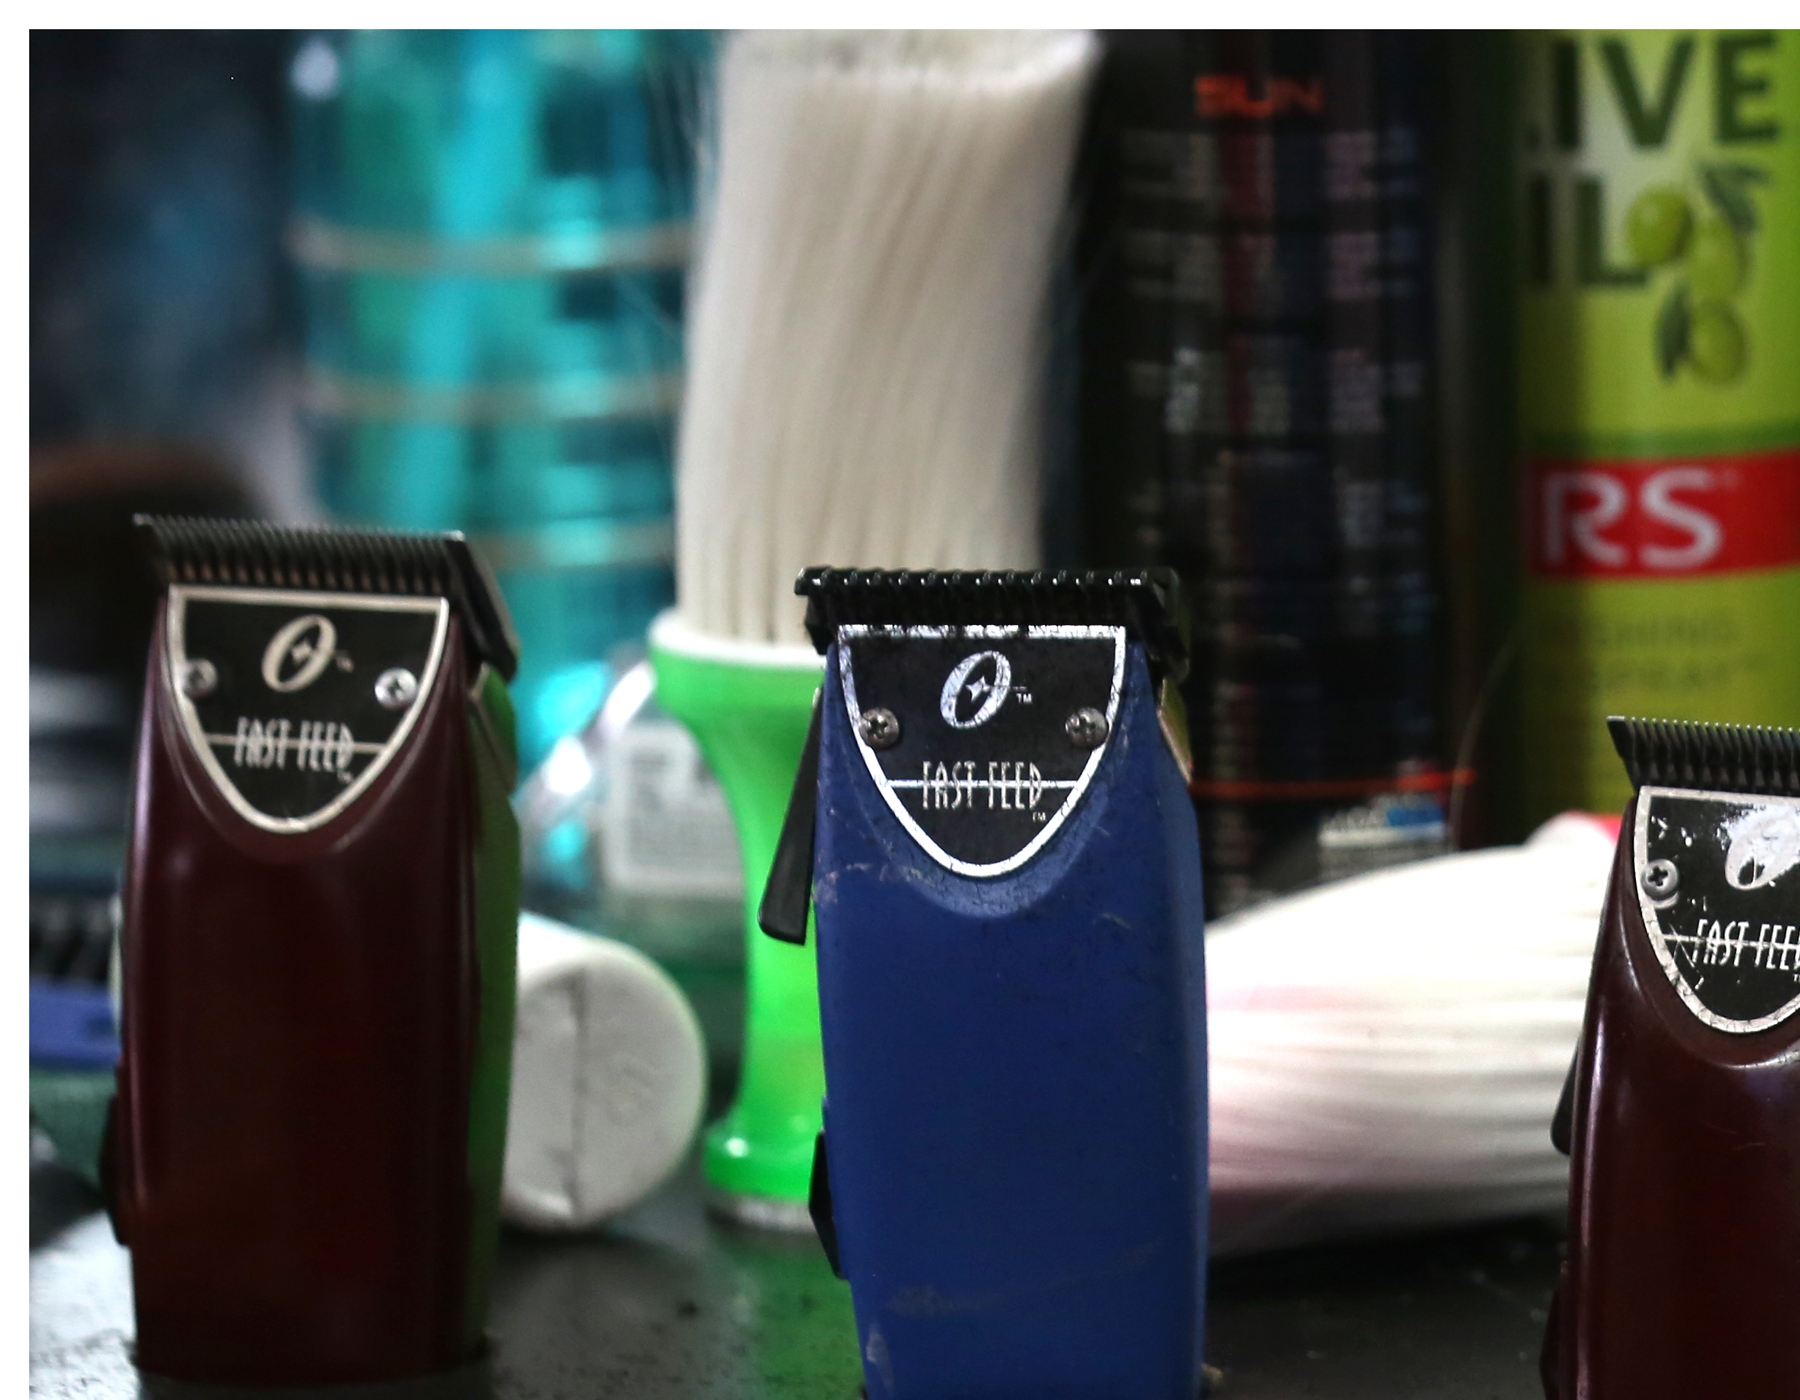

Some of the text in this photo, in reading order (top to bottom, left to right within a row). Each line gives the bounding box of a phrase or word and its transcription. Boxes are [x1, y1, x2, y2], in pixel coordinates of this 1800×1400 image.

[234, 716, 355, 772] FAST FEED
[922, 760, 1043, 809] FAST FEED
[1692, 919, 1750, 967] FAST
